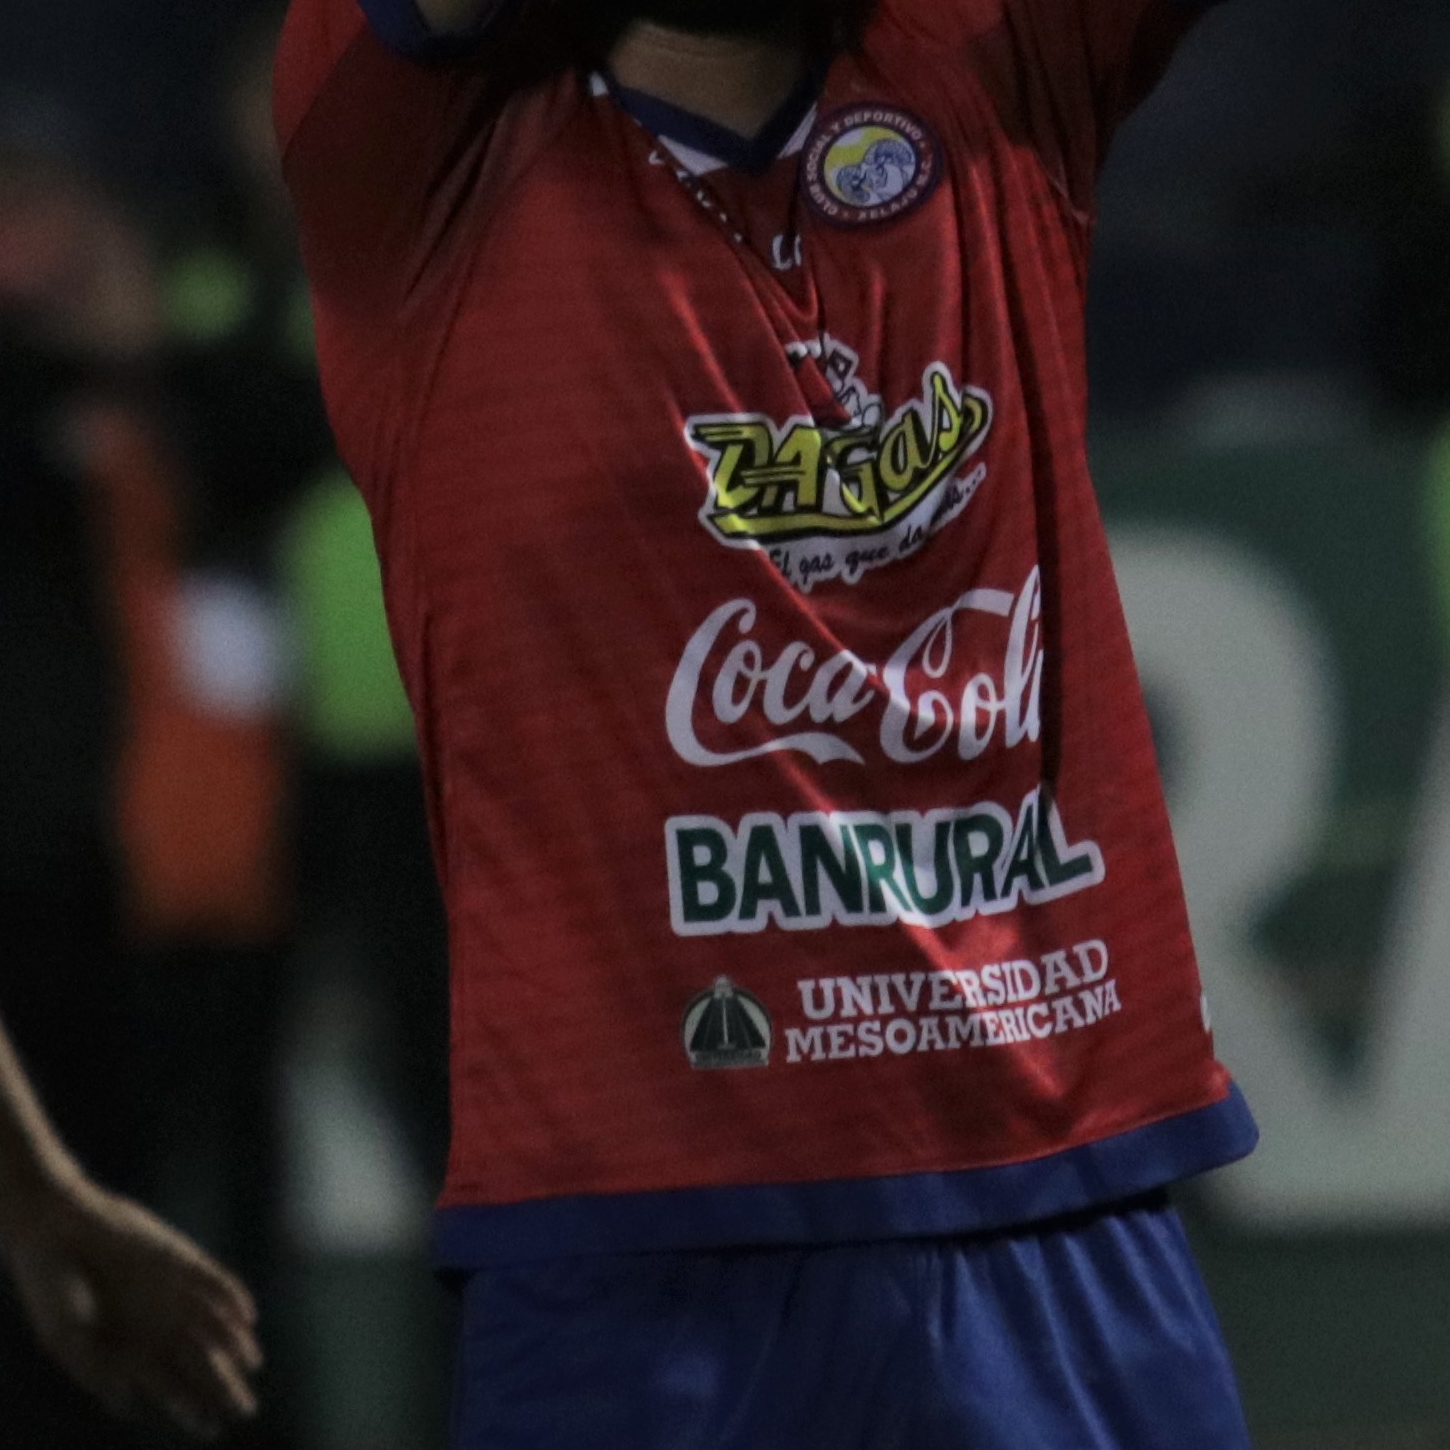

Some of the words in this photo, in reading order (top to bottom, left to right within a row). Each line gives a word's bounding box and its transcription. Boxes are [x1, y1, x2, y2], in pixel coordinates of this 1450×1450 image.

[806, 133, 833, 182] SOCIAL
[843, 111, 924, 140] DEPORTIVO
[799, 553, 833, 586] gas
[845, 544, 890, 575] que
[899, 524, 923, 551] da
[675, 793, 1094, 925] BANRURAL
[796, 938, 1111, 1020] UNIVERSIDAD
[784, 979, 1123, 1065] MESOAMERICANA
